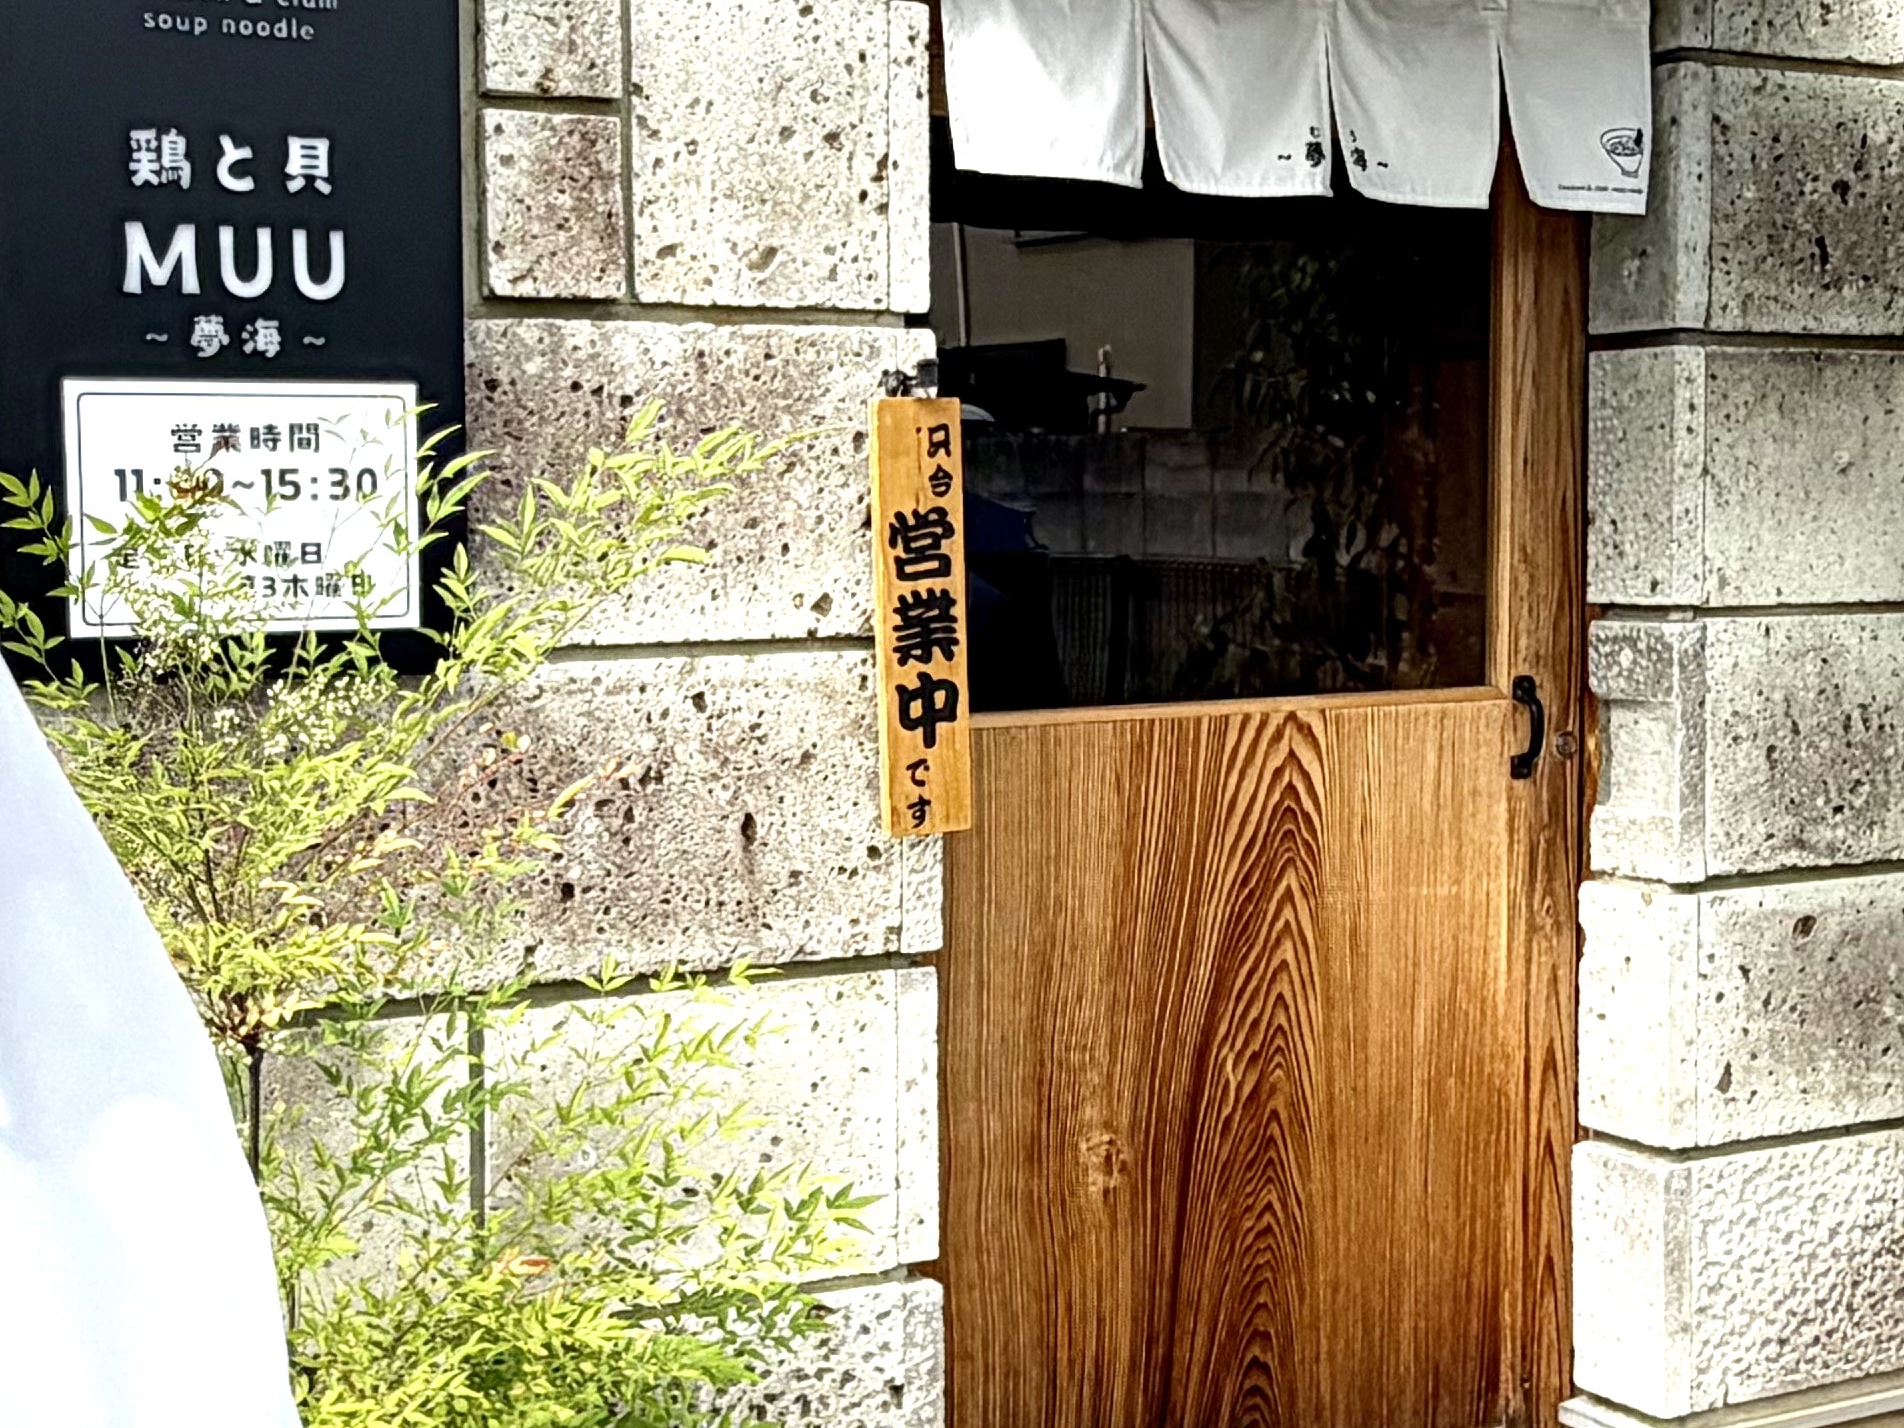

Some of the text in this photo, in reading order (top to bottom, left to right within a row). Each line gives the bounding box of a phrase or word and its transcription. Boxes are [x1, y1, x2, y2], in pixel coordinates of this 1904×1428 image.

[143, 12, 315, 40] soup noodle
[128, 127, 333, 196] 鶏と貝
[122, 221, 346, 301] MUU
[170, 422, 320, 454] 営業時間
